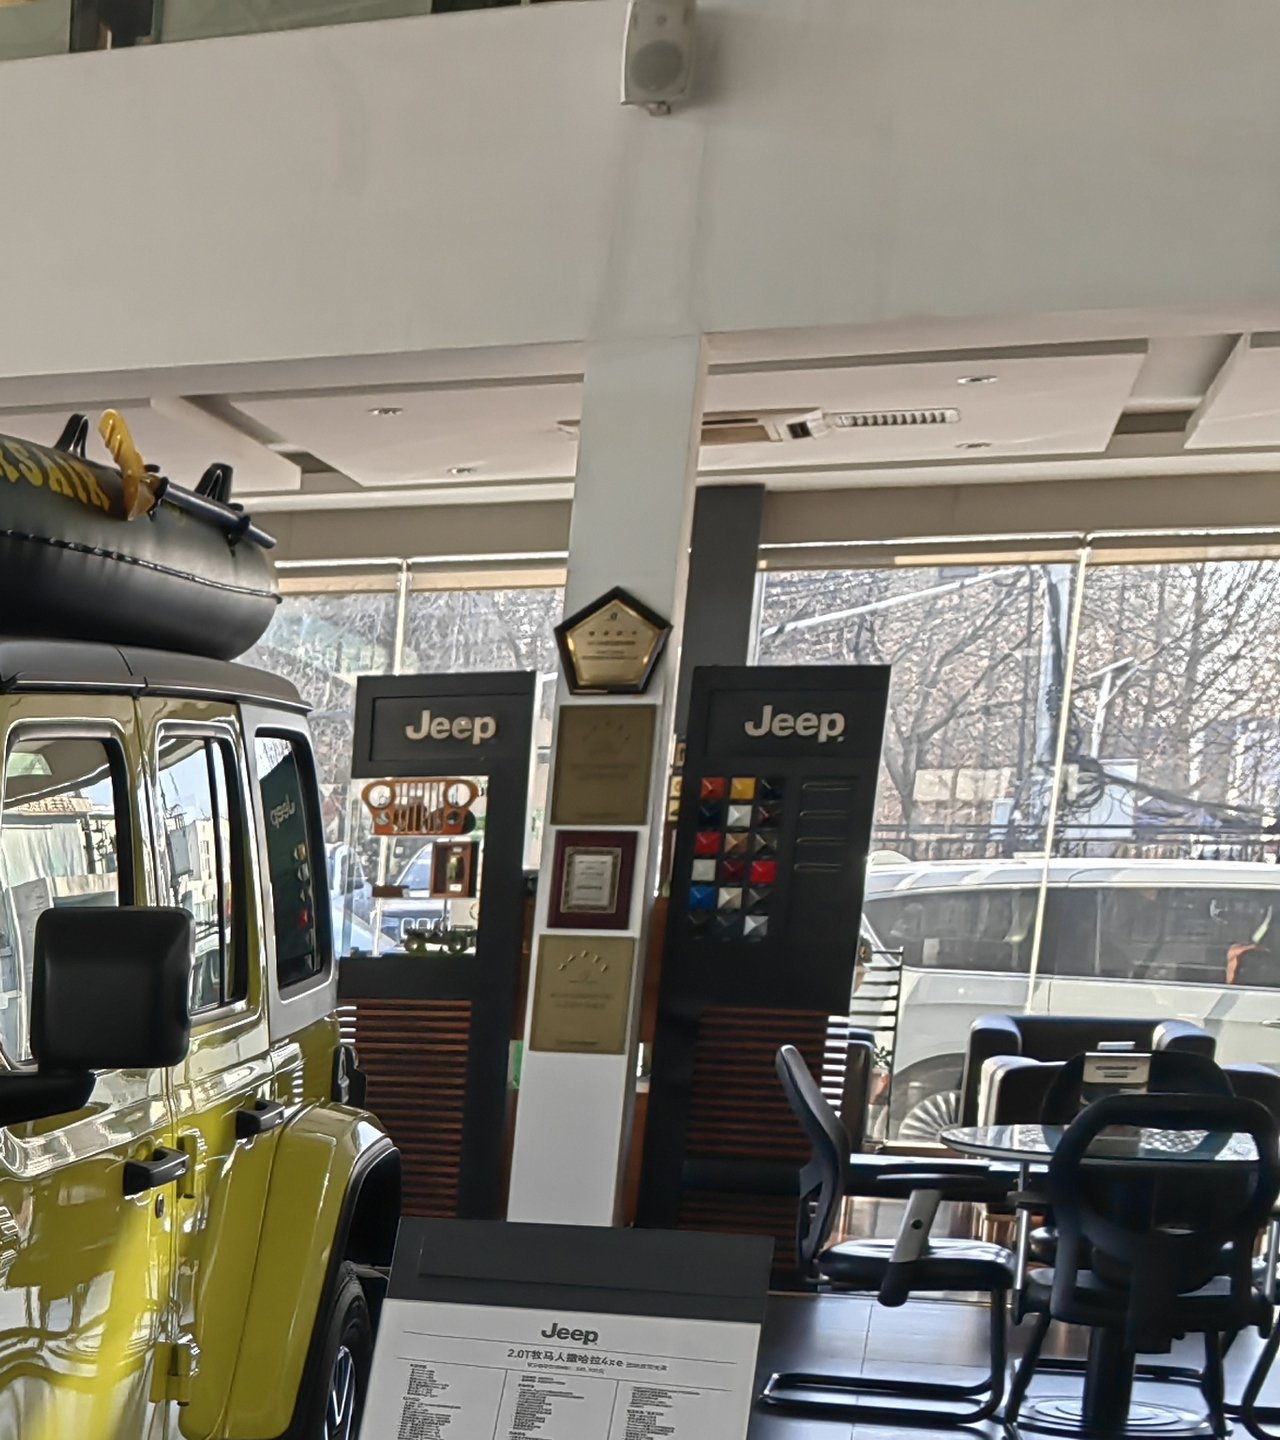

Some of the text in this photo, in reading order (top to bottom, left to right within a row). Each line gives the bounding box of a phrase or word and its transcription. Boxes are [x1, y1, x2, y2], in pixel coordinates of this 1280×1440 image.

[405, 710, 497, 745] Jeep
[744, 705, 846, 743] Jeep
[541, 1322, 599, 1345] Jeep
